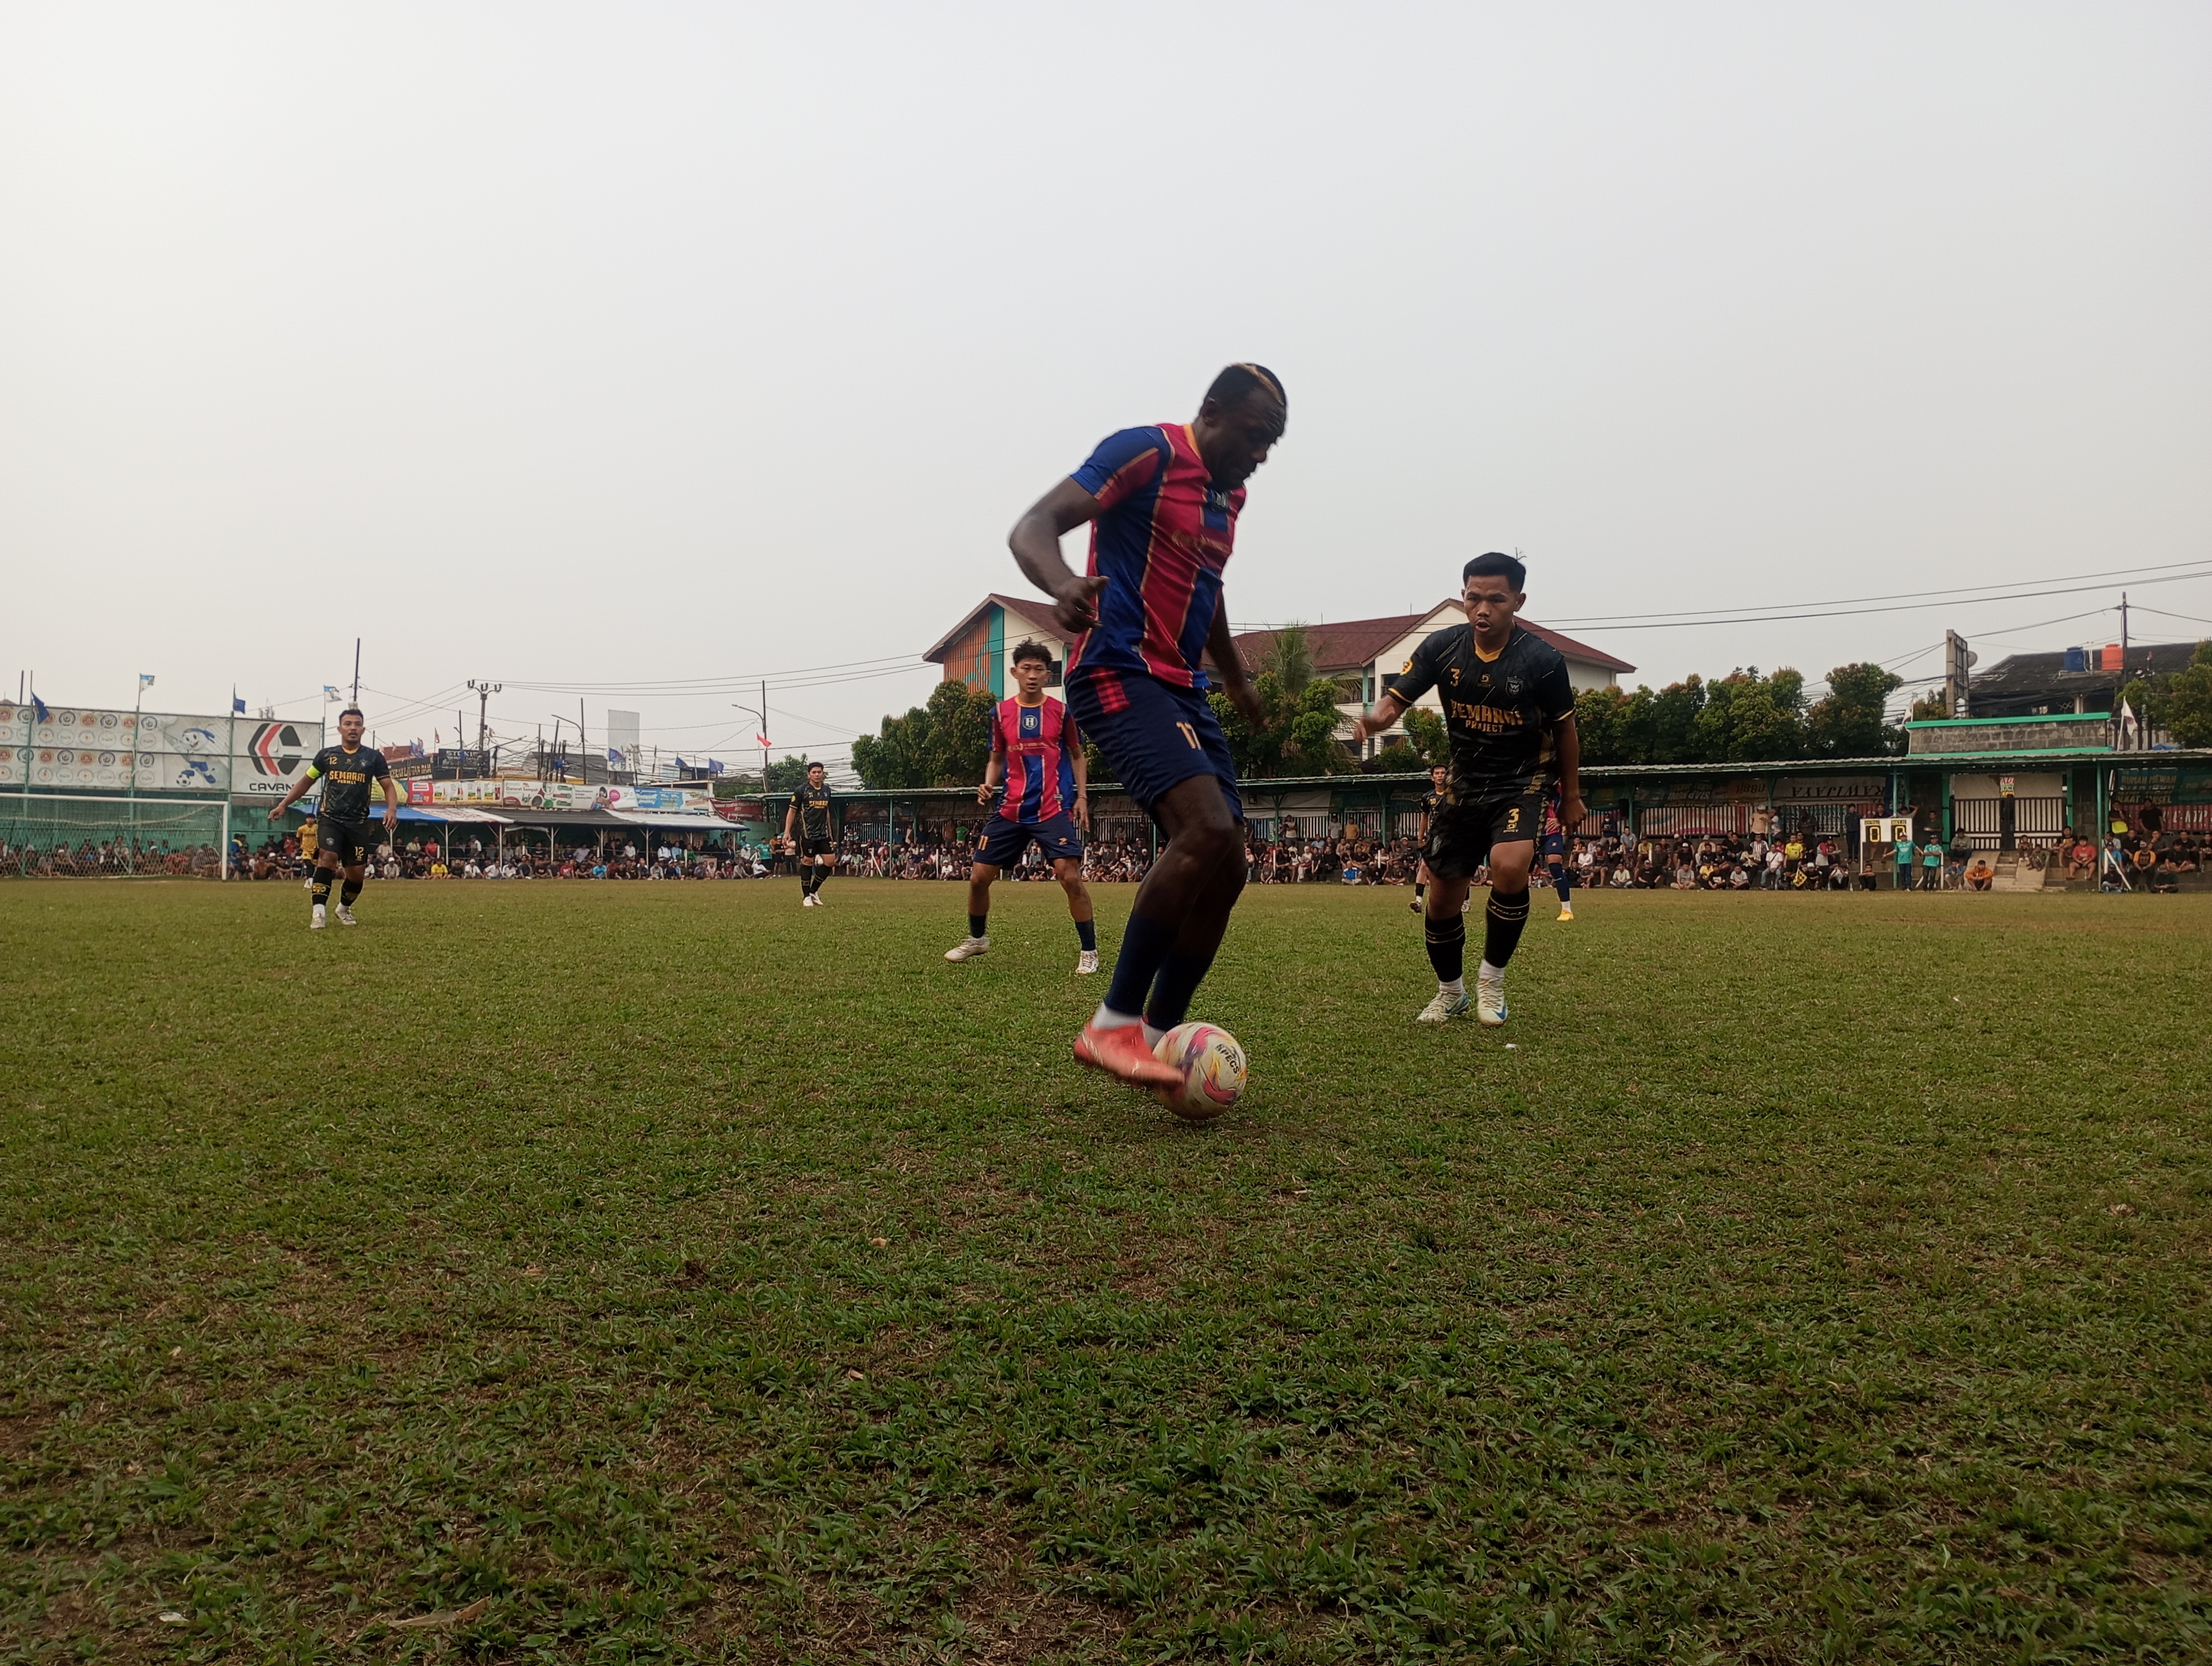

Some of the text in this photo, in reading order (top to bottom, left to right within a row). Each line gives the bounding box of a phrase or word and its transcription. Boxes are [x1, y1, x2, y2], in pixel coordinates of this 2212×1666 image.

[1450, 668, 1461, 687] 3
[329, 757, 337, 765] 12
[1507, 808, 1520, 823] 3
[1869, 826, 1880, 843] 0
[355, 846, 364, 856] 12
